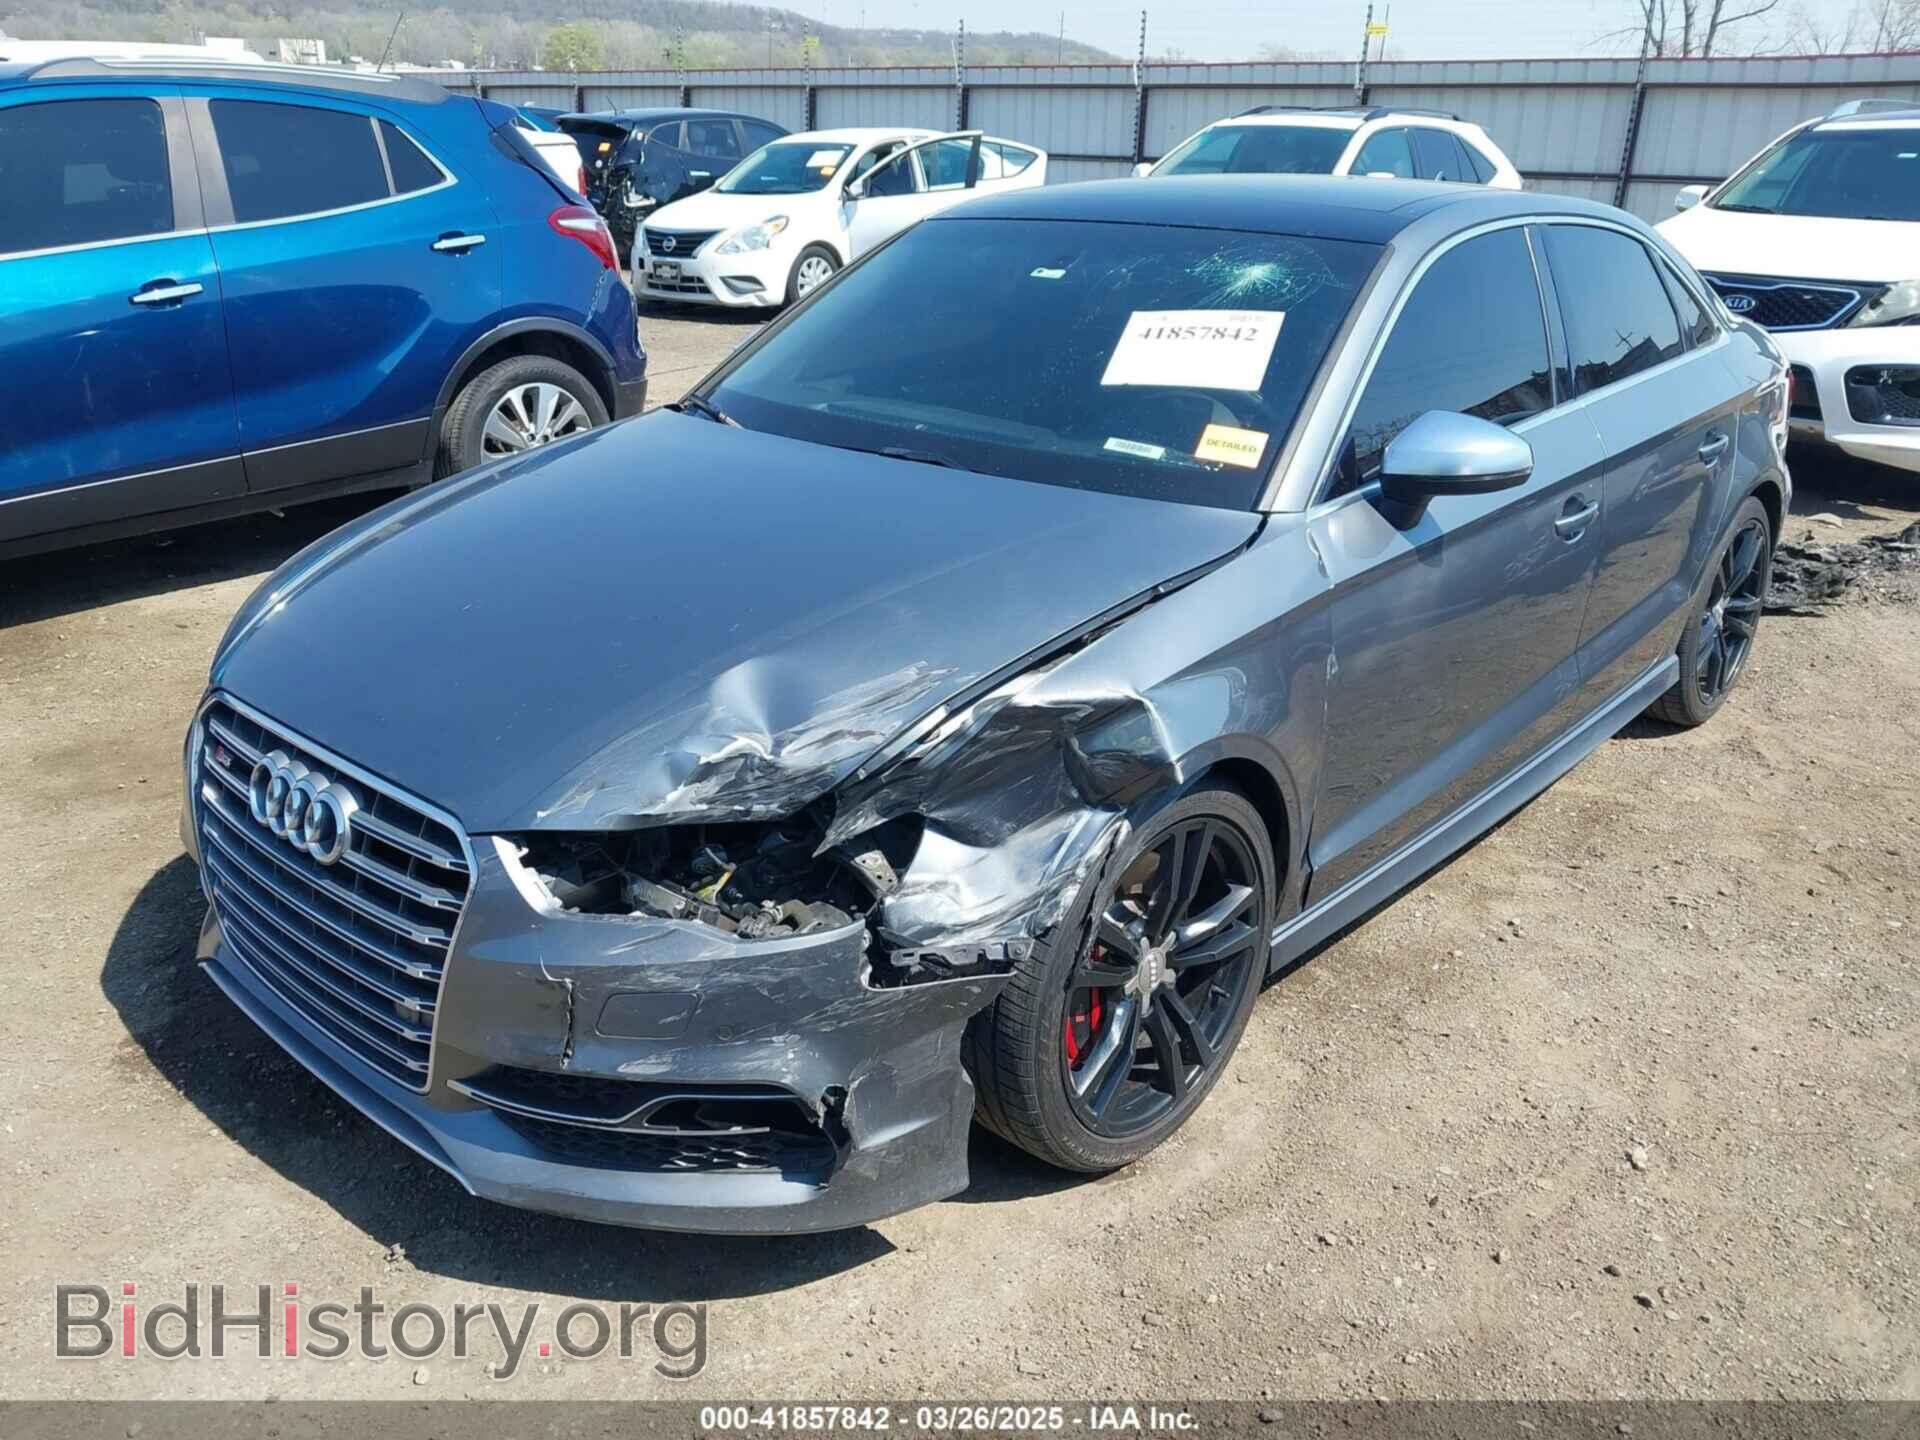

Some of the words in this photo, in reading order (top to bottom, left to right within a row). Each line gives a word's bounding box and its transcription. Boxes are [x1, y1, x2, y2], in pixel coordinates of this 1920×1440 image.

[1724, 297, 1748, 308] KIA
[1138, 326, 1259, 342] 41857842
[1206, 438, 1258, 454] DETAILED
